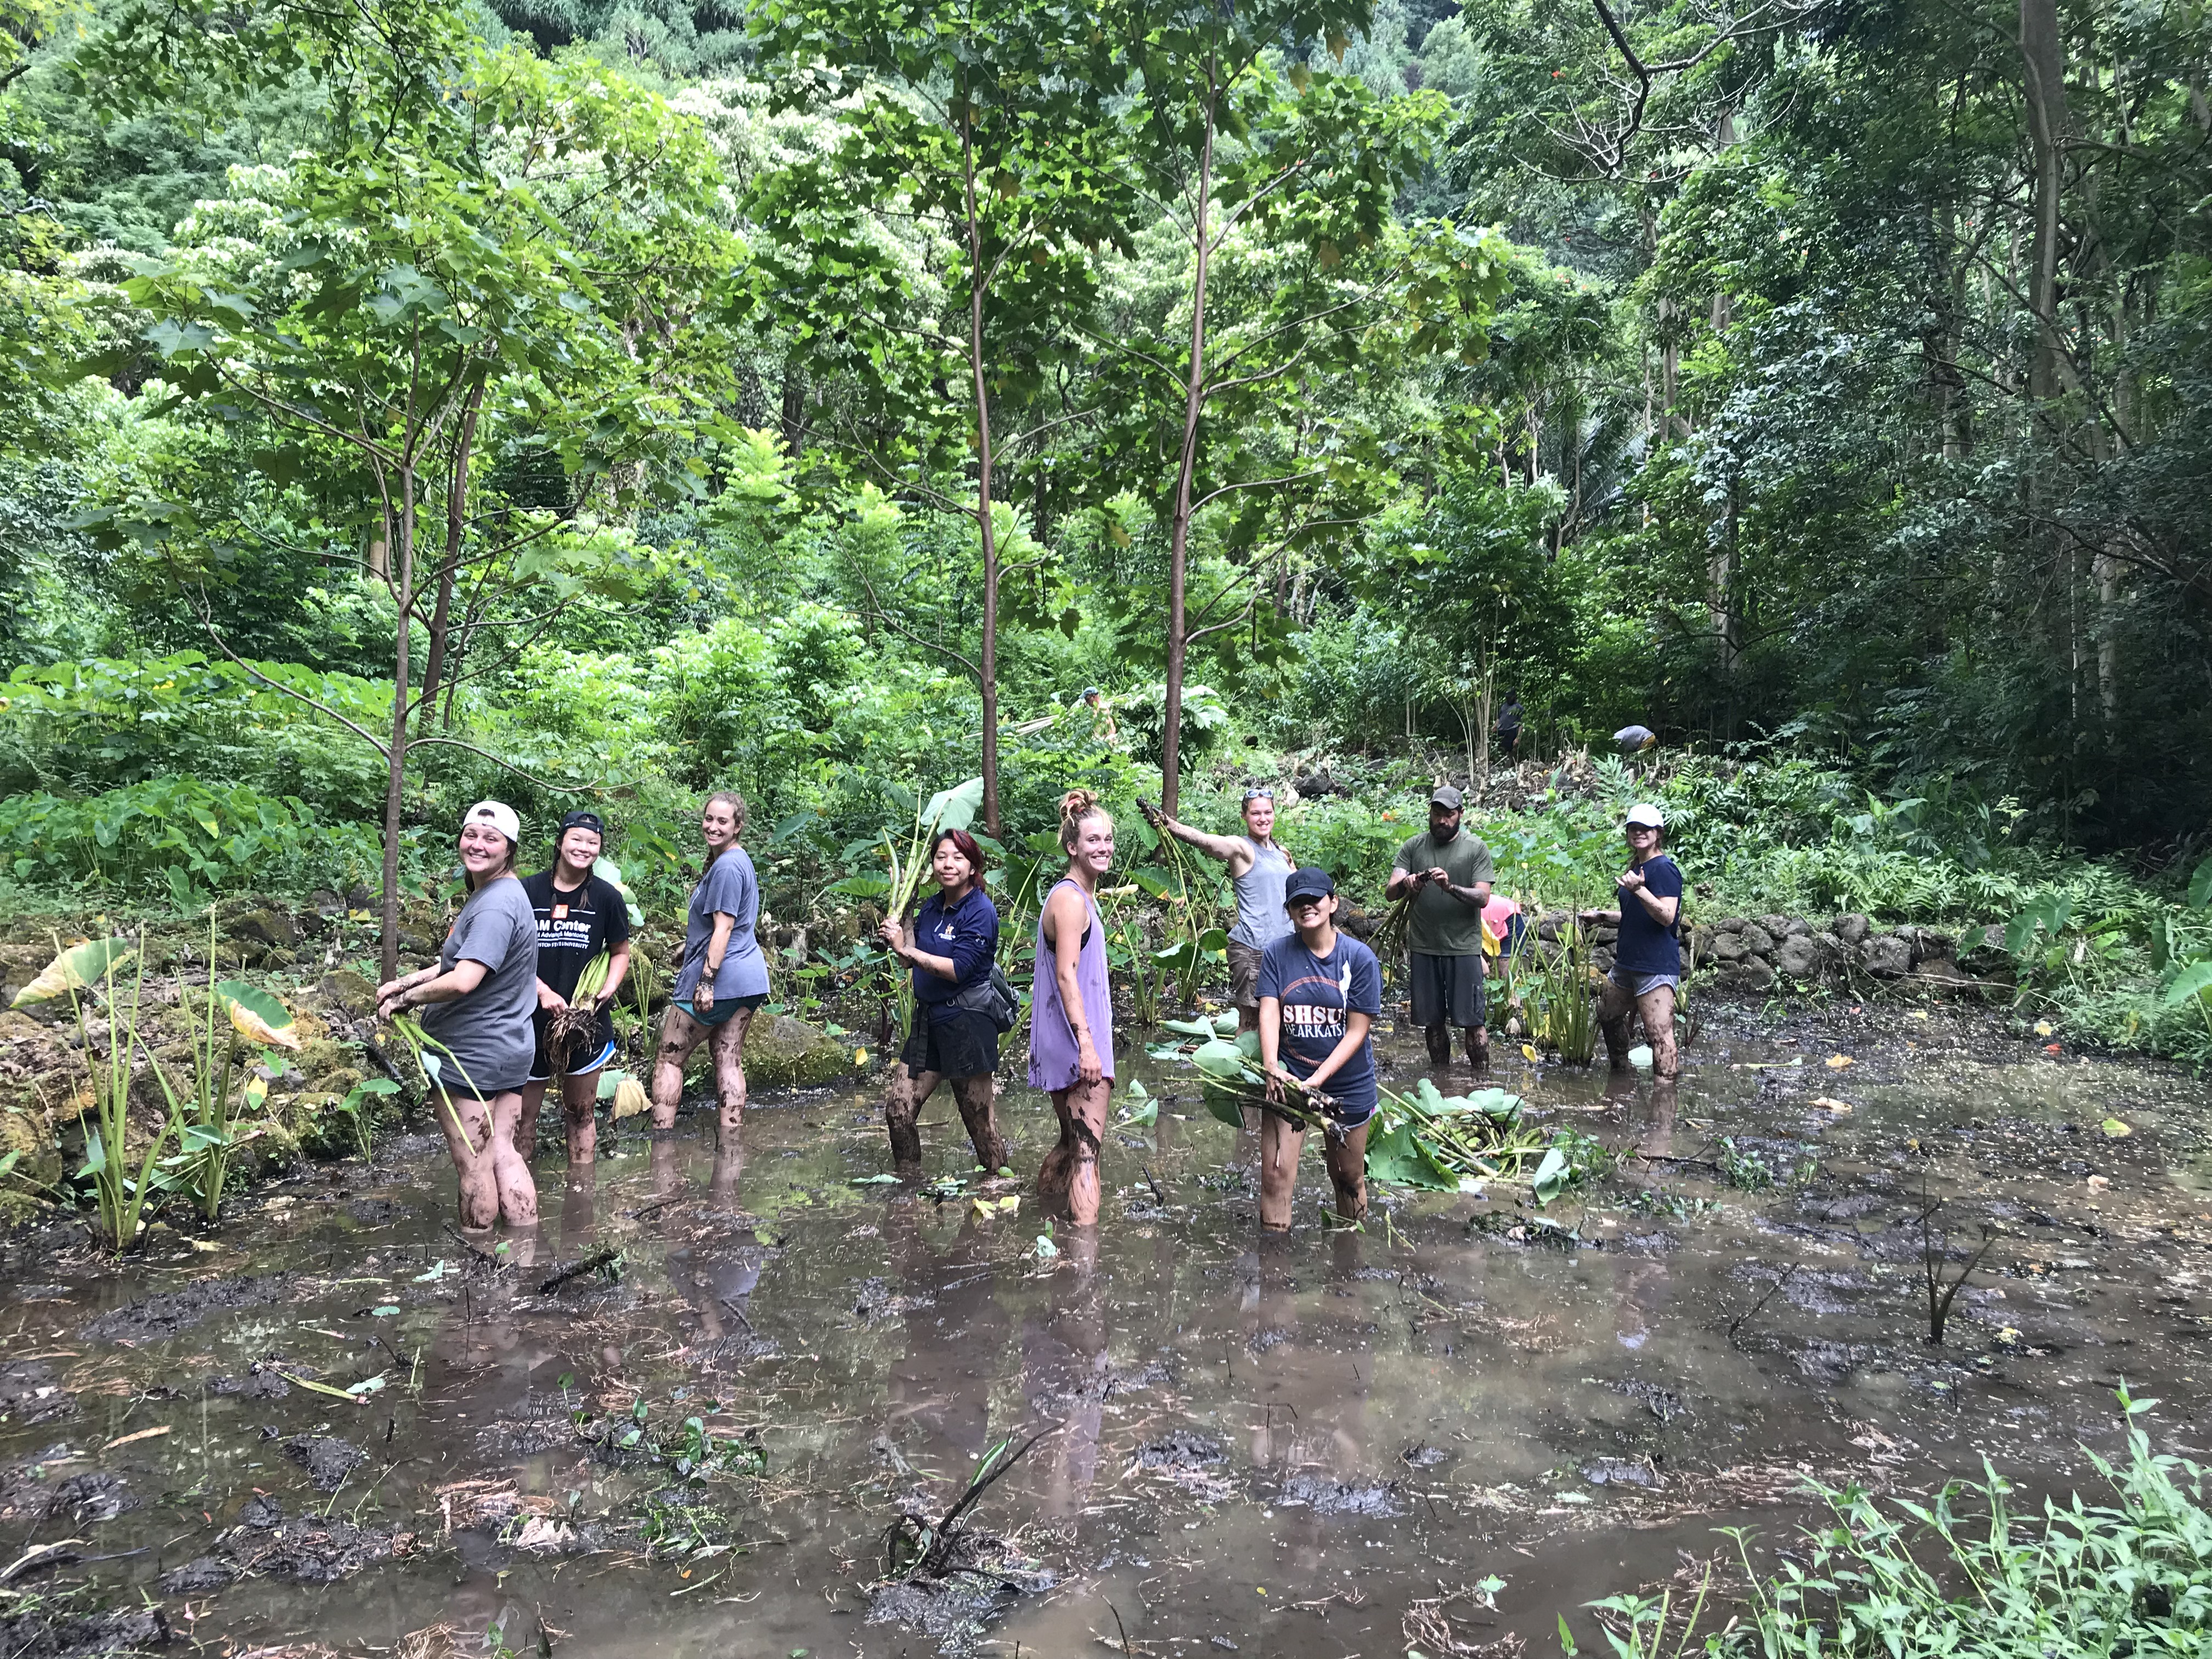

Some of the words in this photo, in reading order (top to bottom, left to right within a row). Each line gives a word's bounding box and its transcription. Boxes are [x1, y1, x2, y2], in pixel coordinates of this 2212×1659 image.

[554, 920, 591, 933] Center
[563, 930, 589, 940] Mentoring
[1283, 1005, 1343, 1024] SHSU
[1284, 1023, 1342, 1037] BEARKATS
